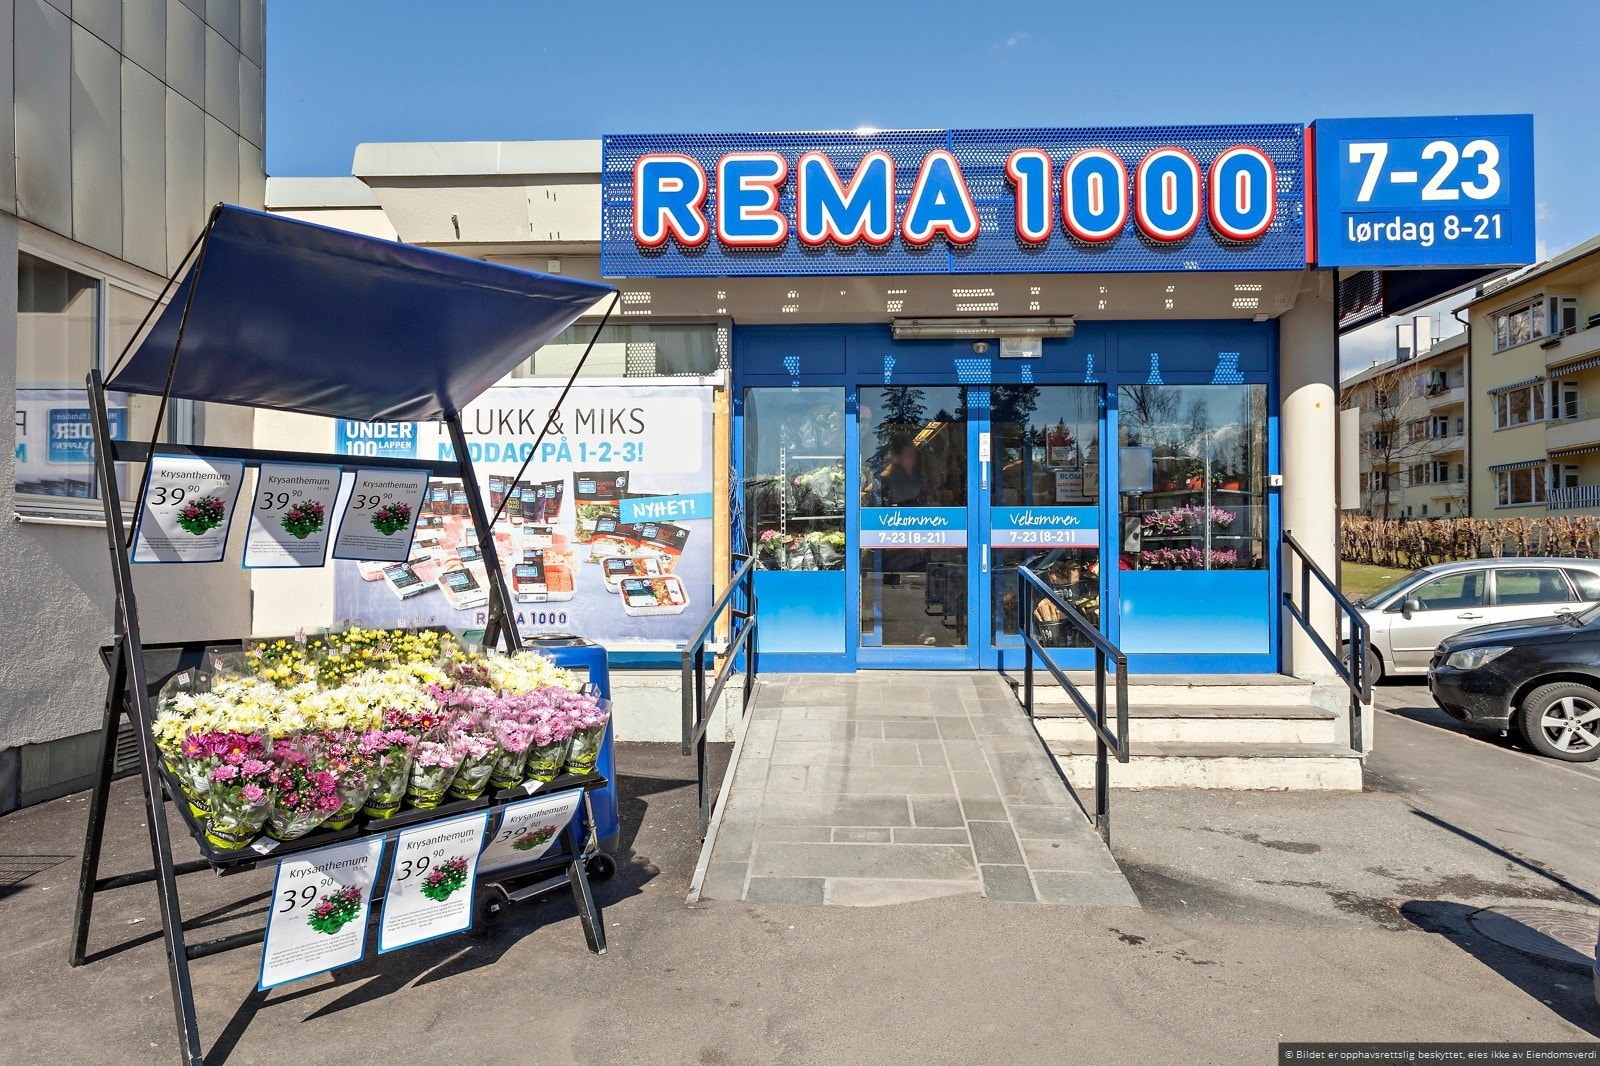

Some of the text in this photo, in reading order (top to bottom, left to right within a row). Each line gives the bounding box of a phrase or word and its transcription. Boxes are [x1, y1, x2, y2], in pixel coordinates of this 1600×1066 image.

[1348, 138, 1502, 203] 7-23
[632, 145, 1277, 248] REMA 1000
[1347, 213, 1502, 246] lørdag 8-21
[346, 422, 413, 439] UNDER
[438, 408, 645, 435] LUKK & MIKS
[346, 441, 412, 457] 100 LAPPEN
[438, 437, 644, 463] MDDAG PÅ 1-2-3!
[161, 470, 230, 481] Krysanthemum
[268, 476, 330, 485] Krysanthemum
[363, 481, 418, 489] Krysanthemum
[152, 487, 185, 506] 39
[260, 492, 290, 510] 39
[353, 495, 380, 510] 39
[633, 500, 696, 518] NYHET!
[1010, 510, 1081, 526] Velkommen
[879, 511, 949, 527] Velkommen
[879, 532, 946, 544] 7-23 (8-21)
[1010, 530, 1076, 543] 7-23 (8-21)
[476, 613, 567, 624] RA 1000
[510, 805, 569, 824] Krysanthemum
[406, 828, 475, 850] Krysanthemum
[496, 821, 541, 843] 39 90
[290, 855, 368, 878] Krysanthemum
[397, 848, 445, 882] 39 90
[280, 878, 334, 913] 39 90
